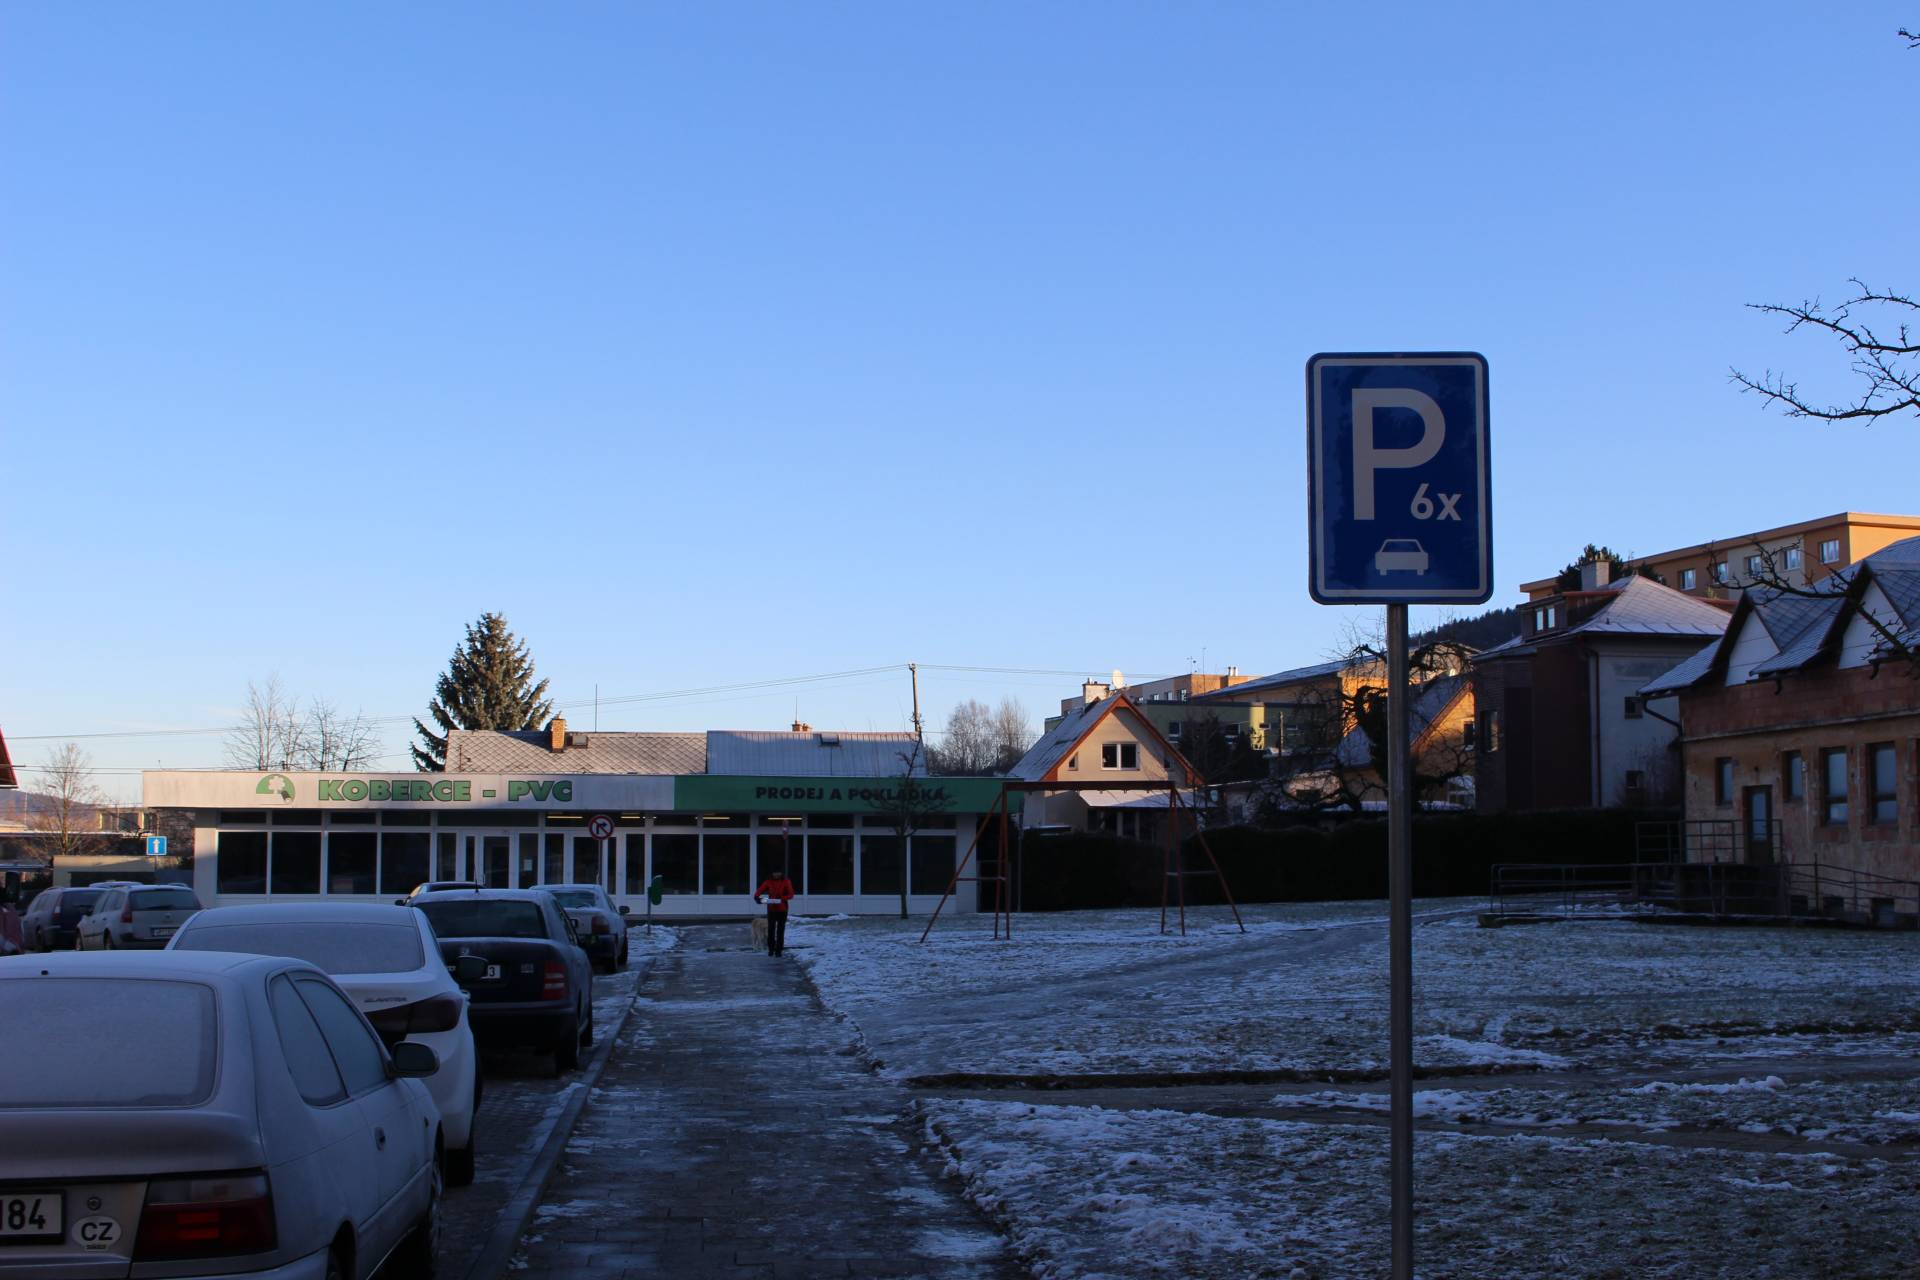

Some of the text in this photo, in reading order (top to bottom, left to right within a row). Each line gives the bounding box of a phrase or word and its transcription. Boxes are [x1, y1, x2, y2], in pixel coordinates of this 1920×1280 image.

[1352, 388, 1446, 520] P
[1410, 483, 1462, 521] 6x
[318, 779, 472, 802] KOBERCE
[507, 780, 573, 802] PVC
[755, 786, 824, 800] PRODEJ
[830, 787, 843, 801] A
[81, 1222, 113, 1241] CZ
